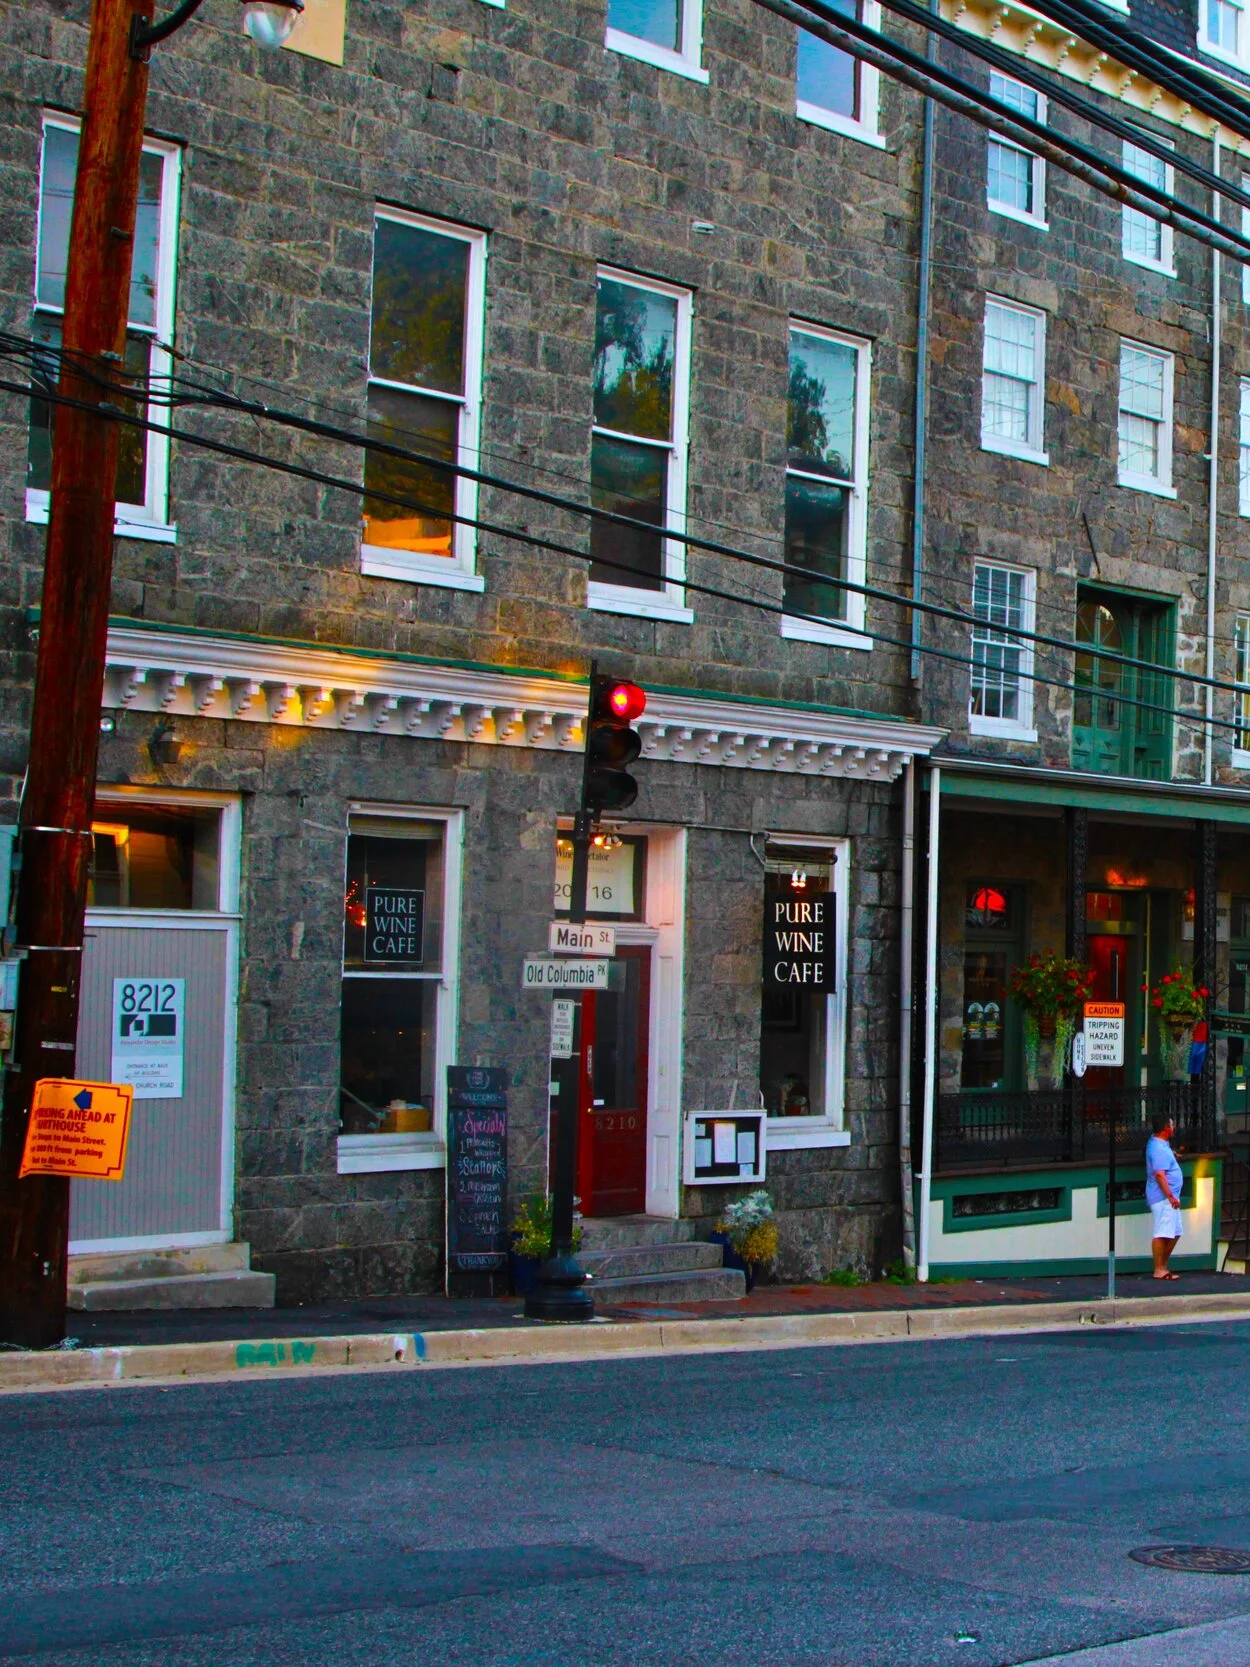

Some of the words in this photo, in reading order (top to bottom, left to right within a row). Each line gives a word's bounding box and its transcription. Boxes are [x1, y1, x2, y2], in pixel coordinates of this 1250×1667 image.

[374, 896, 416, 914] PURE
[775, 903, 823, 923] PURE
[374, 916, 416, 933] WINE
[373, 937, 415, 953] CAFE
[558, 928, 593, 947] Main
[775, 932, 823, 952] WINE
[528, 965, 543, 983] Old
[548, 965, 594, 983] Columbia
[775, 962, 823, 983] CAFE
[122, 984, 176, 1012] 8212
[67, 1109, 102, 1123] AHEAD
[104, 1113, 116, 1124] AT
[596, 1117, 635, 1129] 8210
[74, 1148, 103, 1159] parking
